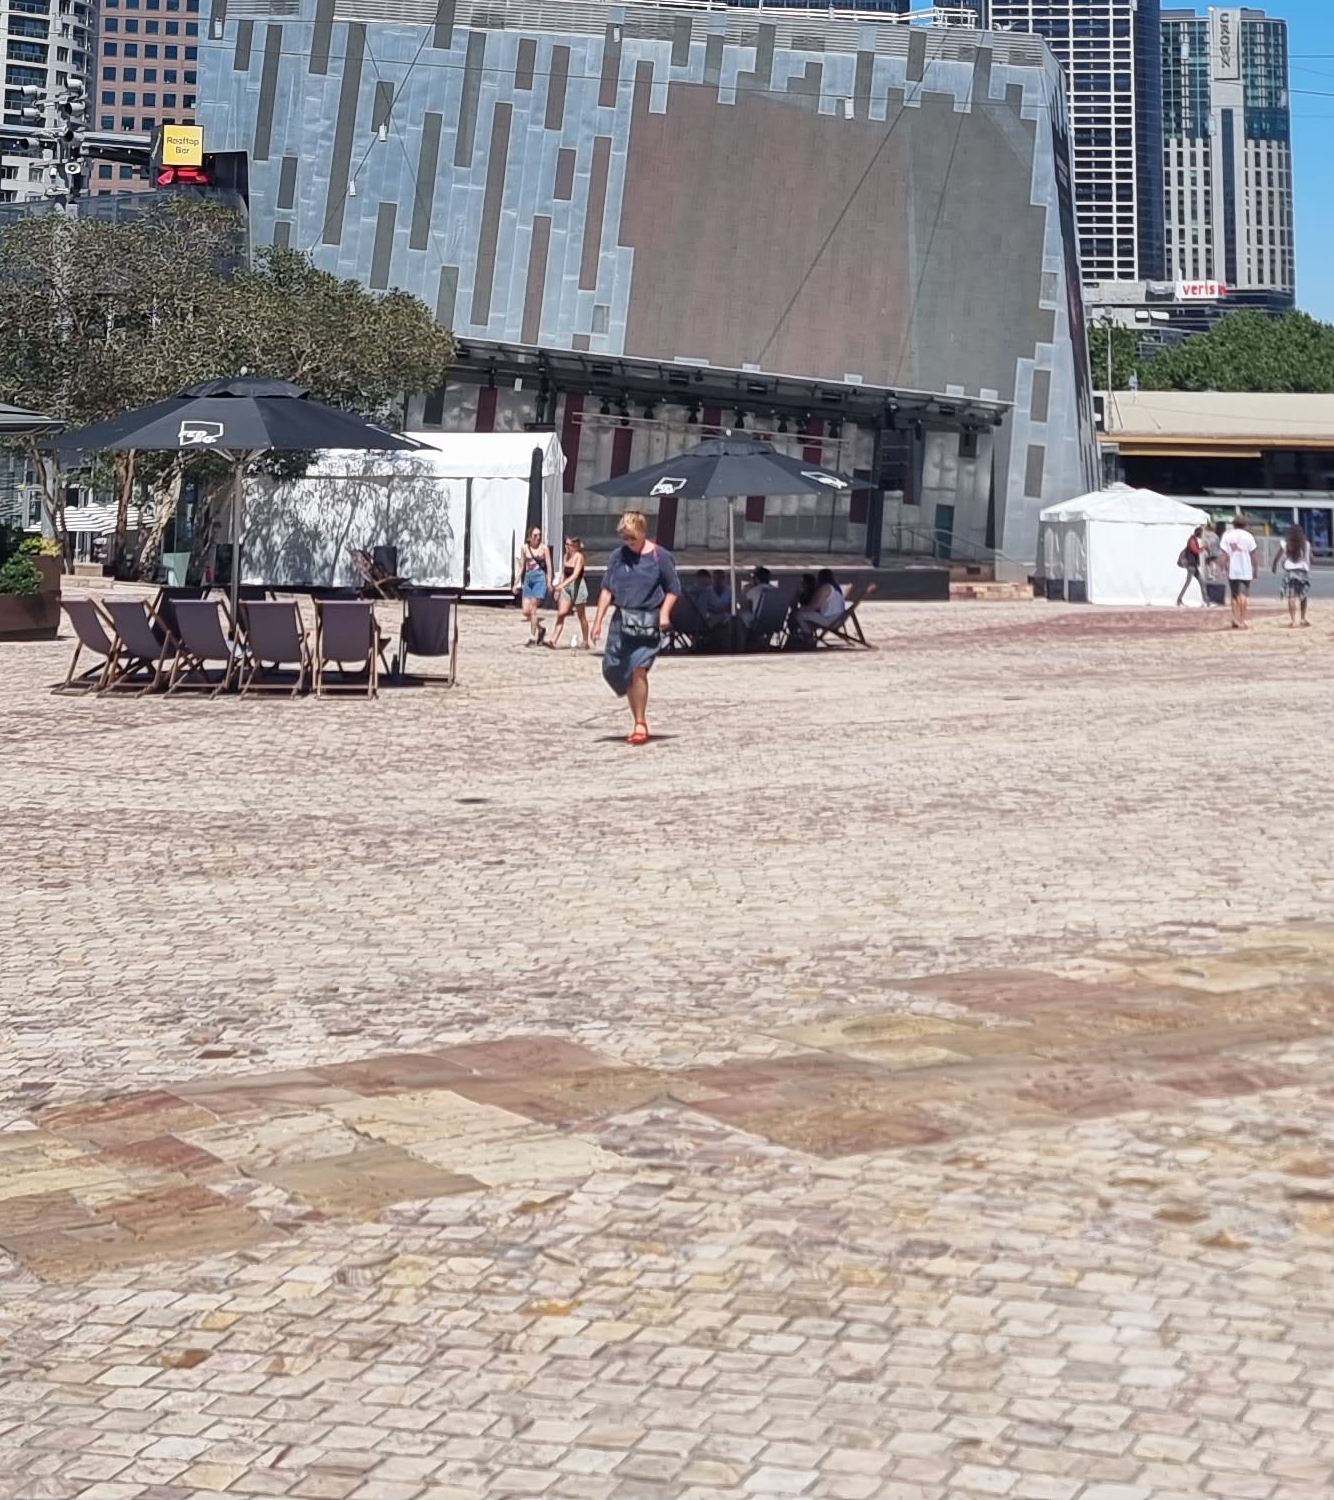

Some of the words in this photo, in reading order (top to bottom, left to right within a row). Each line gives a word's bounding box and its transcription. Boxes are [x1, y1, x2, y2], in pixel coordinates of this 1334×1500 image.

[1219, 12, 1231, 69] CROWN
[166, 136, 200, 147] Rooftop
[175, 146, 190, 154] Bar
